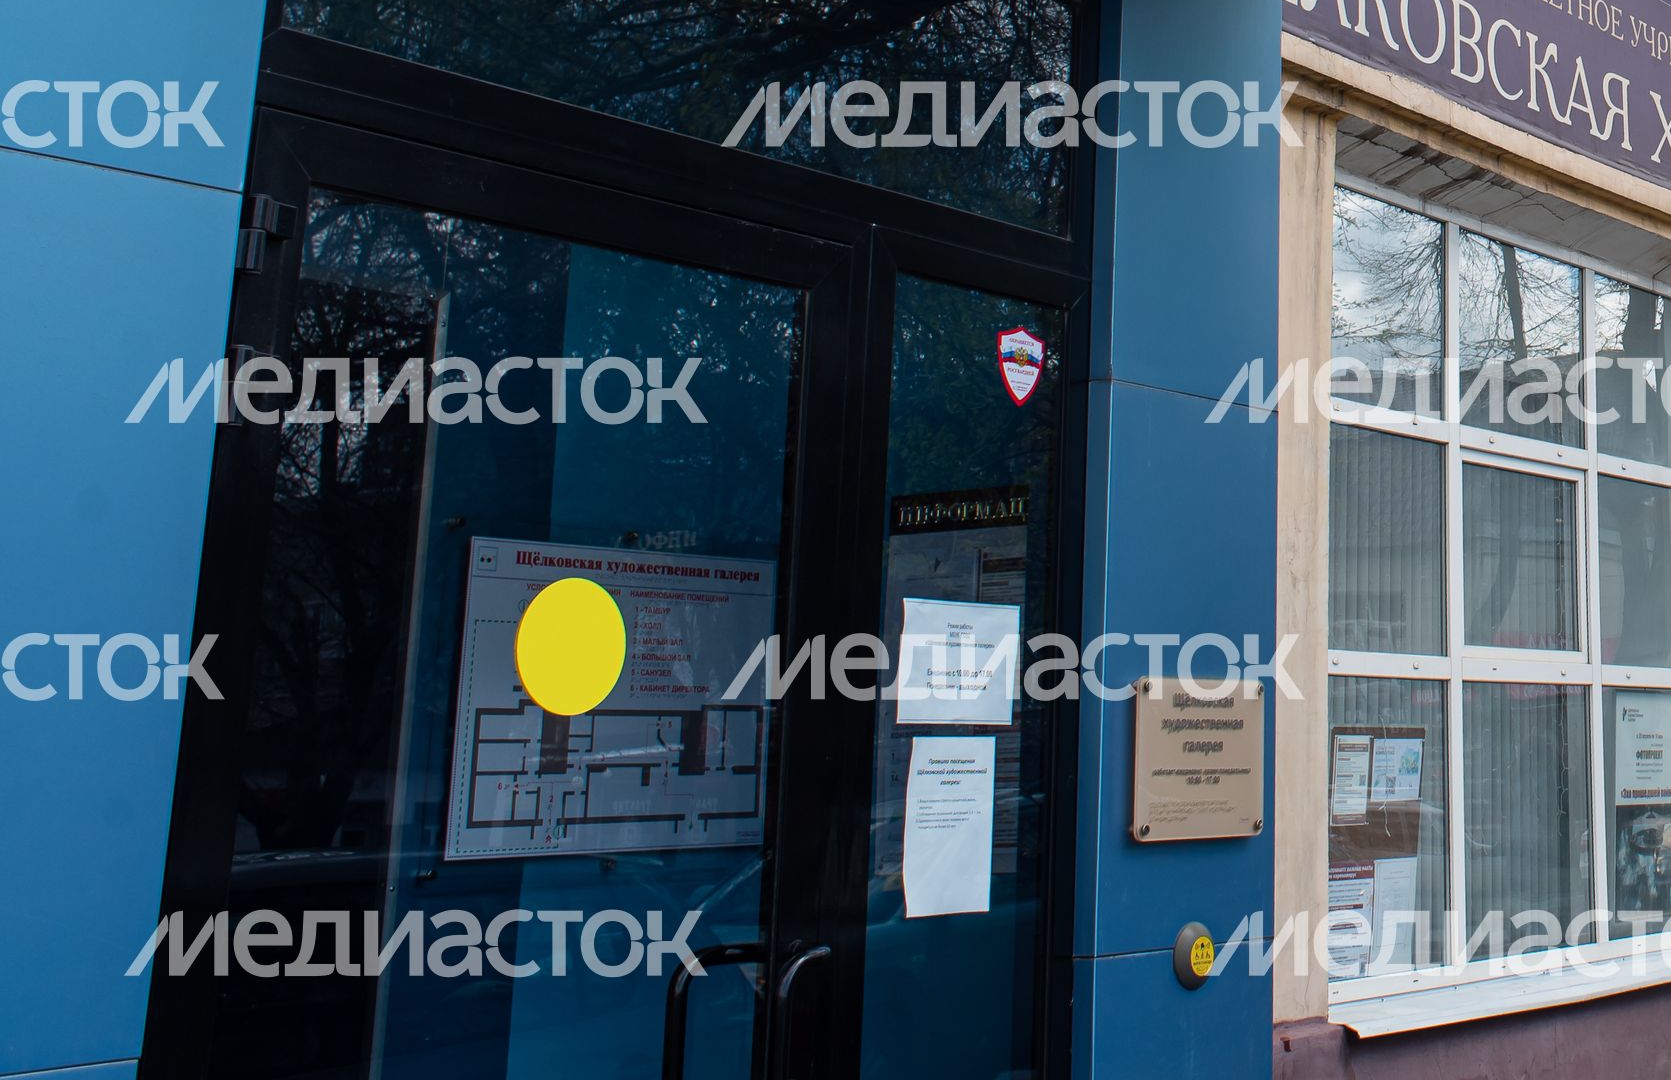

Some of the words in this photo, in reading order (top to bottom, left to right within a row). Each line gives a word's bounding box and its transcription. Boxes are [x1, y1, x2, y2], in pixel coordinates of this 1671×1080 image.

[516, 549, 602, 570] Щёлковская
[606, 561, 710, 579] художественная
[713, 567, 760, 582] галерея
[1172, 693, 1235, 712] Щёлковская
[1161, 718, 1244, 735] художественная
[1182, 740, 1224, 756] галерея
